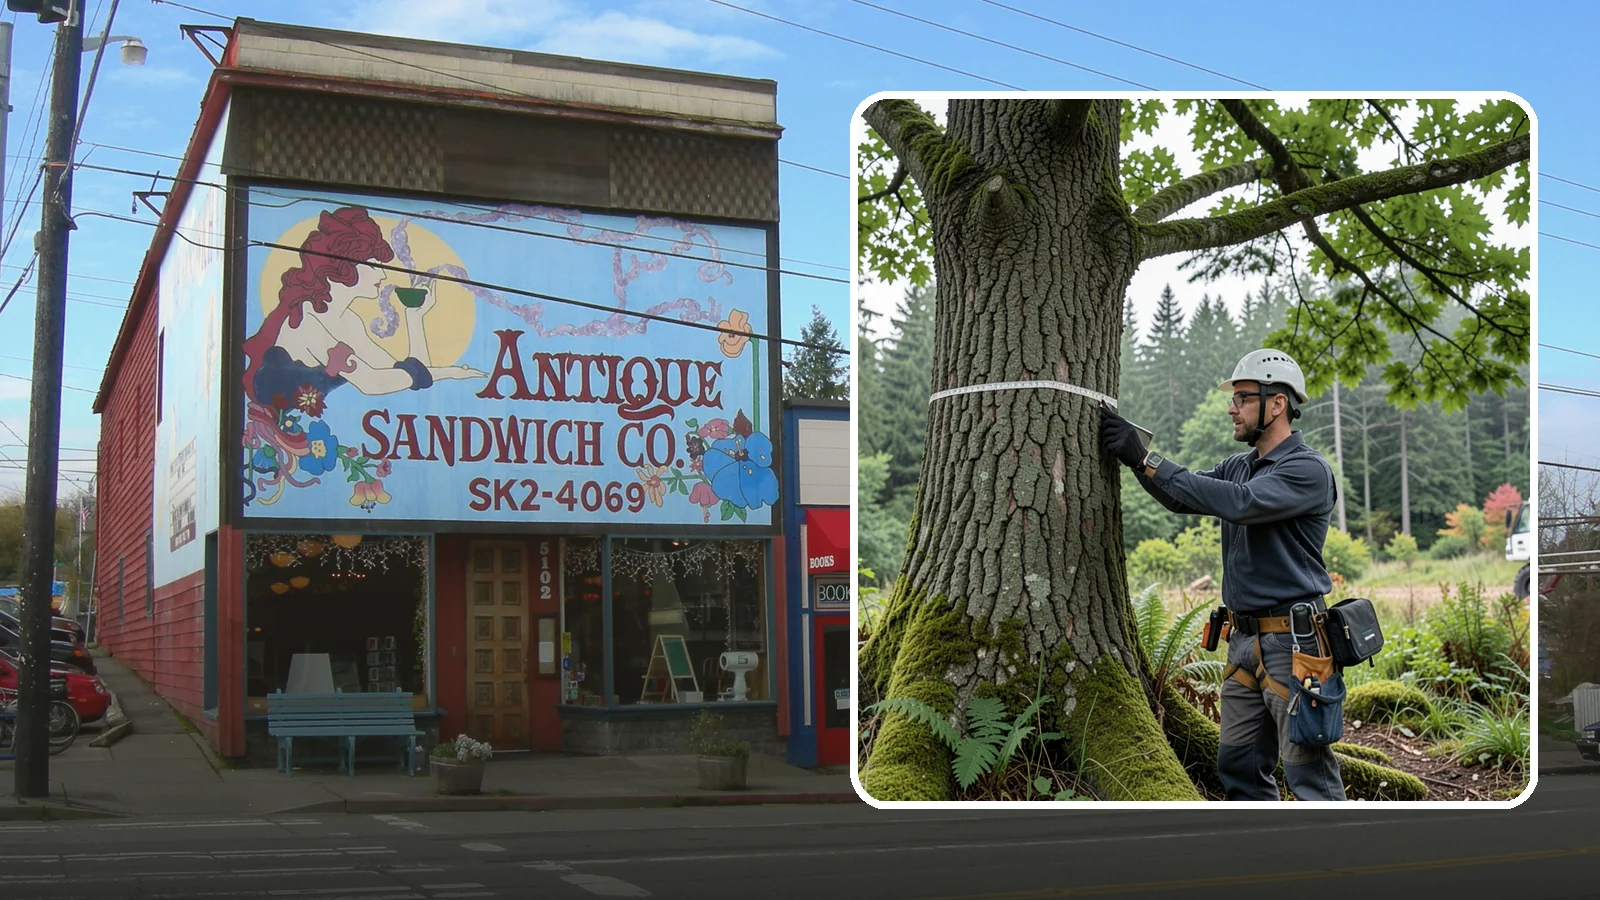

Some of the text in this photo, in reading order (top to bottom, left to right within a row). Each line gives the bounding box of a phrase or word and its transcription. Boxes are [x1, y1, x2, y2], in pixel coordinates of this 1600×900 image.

[476, 329, 723, 421] ANTIQUE
[362, 409, 685, 468] SANDWICH CO.
[469, 477, 645, 513] SK2-4069
[540, 542, 552, 600] 5102
[810, 555, 834, 568] BOOKS
